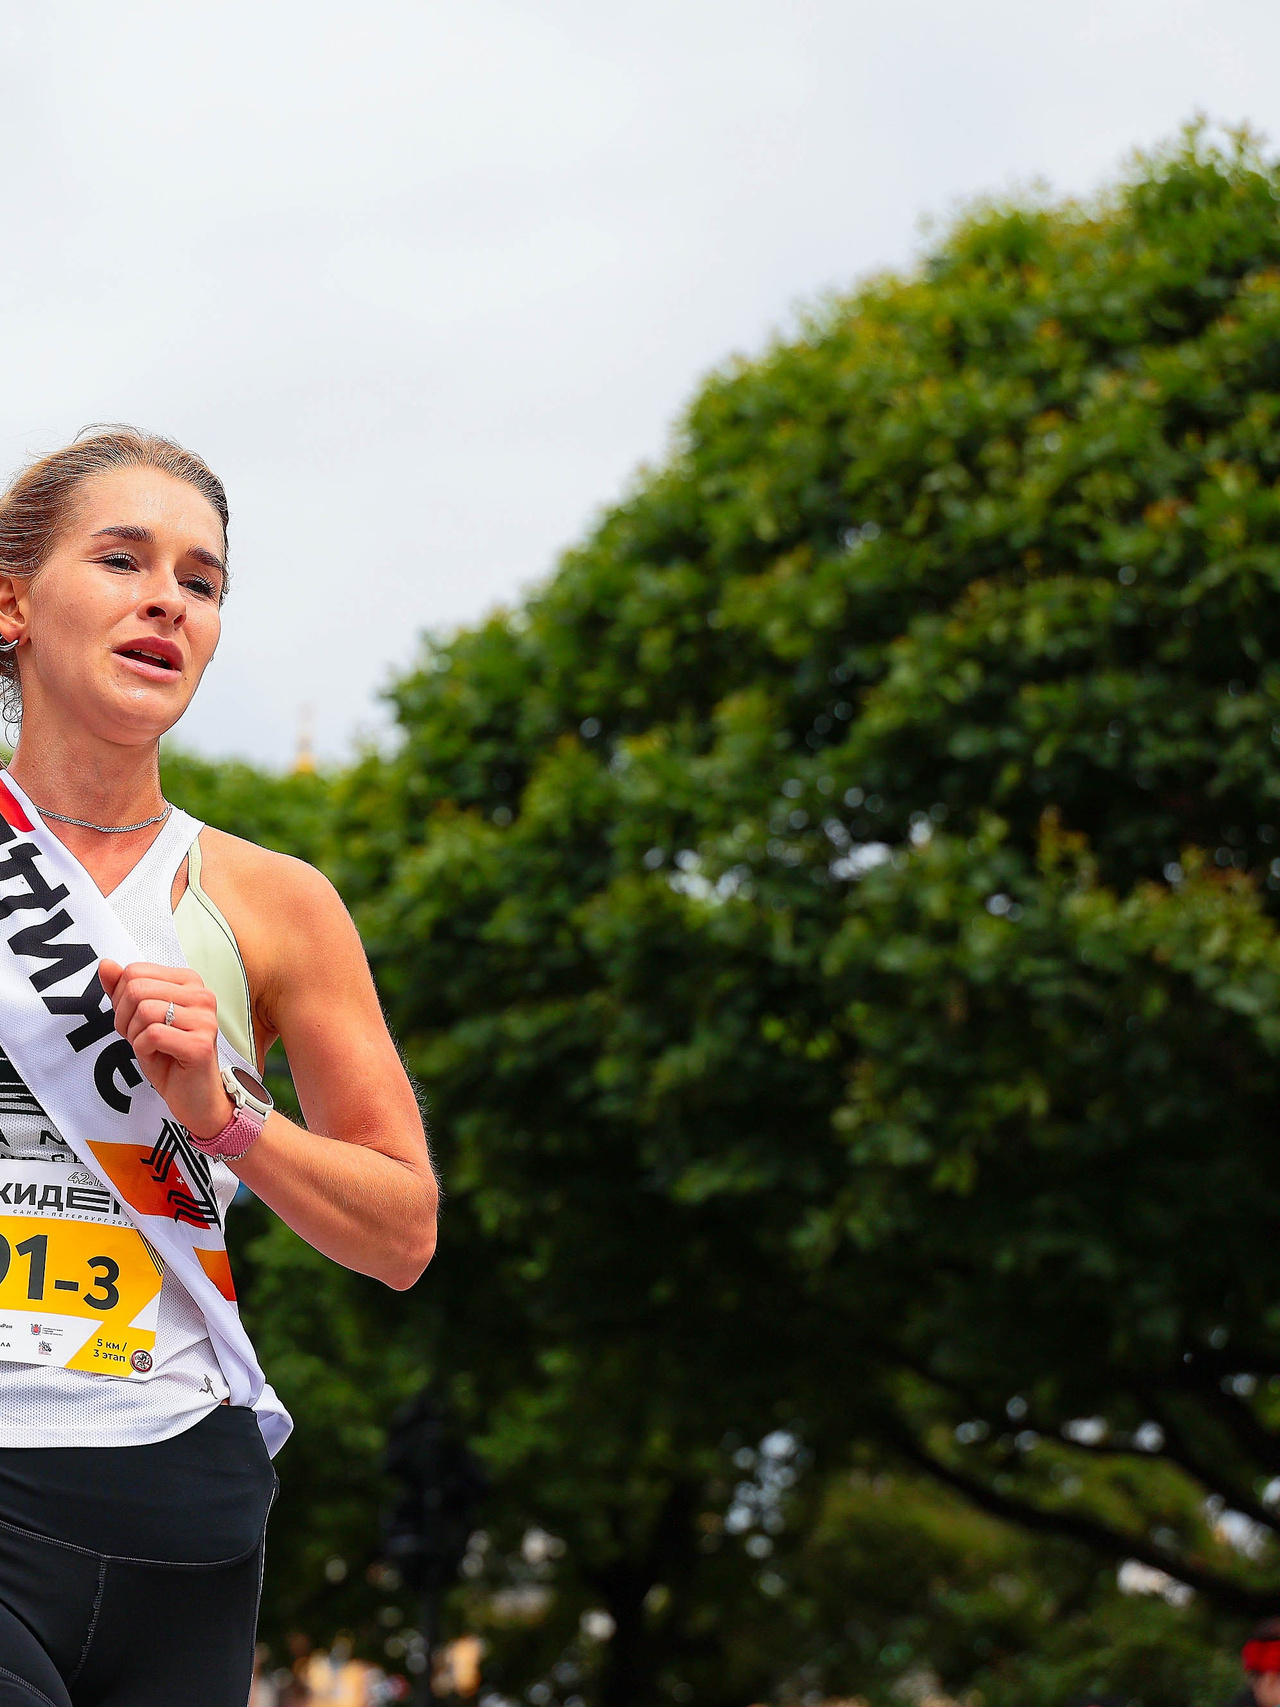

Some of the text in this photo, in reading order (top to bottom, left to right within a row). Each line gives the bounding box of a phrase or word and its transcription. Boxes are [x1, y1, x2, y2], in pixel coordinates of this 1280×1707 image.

[12, 1208, 108, 1223] САНКТ-ПЕТЕРБУРГ
[97, 1338, 103, 1347] 5
[105, 1341, 120, 1350] км
[93, 1348, 126, 1363] 3 этап
